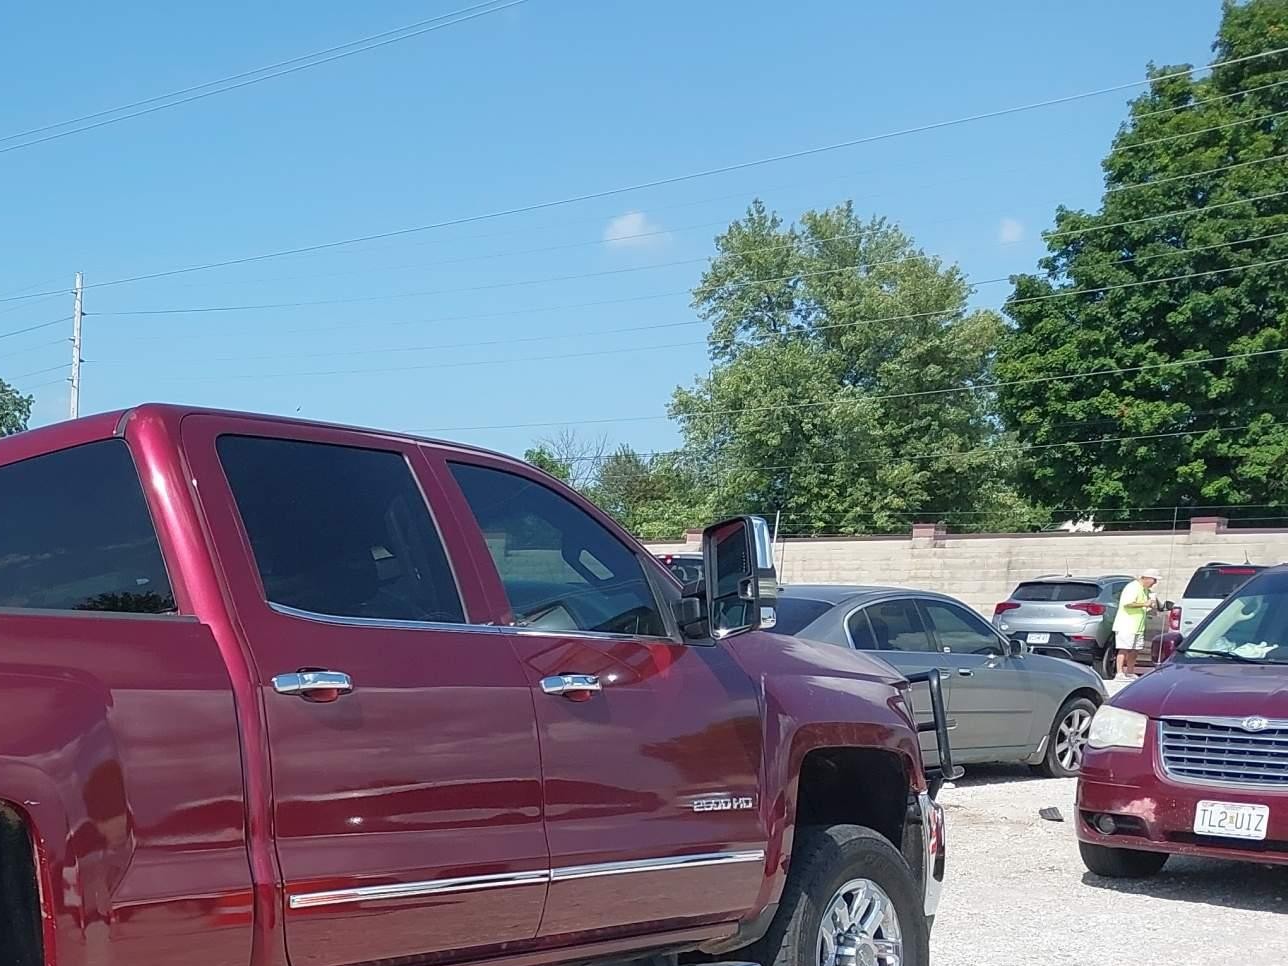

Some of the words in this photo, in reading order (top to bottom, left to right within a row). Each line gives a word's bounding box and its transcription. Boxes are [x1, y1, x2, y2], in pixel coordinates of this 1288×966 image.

[693, 799, 731, 812] 2500
[732, 797, 753, 809] HD
[1200, 808, 1228, 828] TL2
